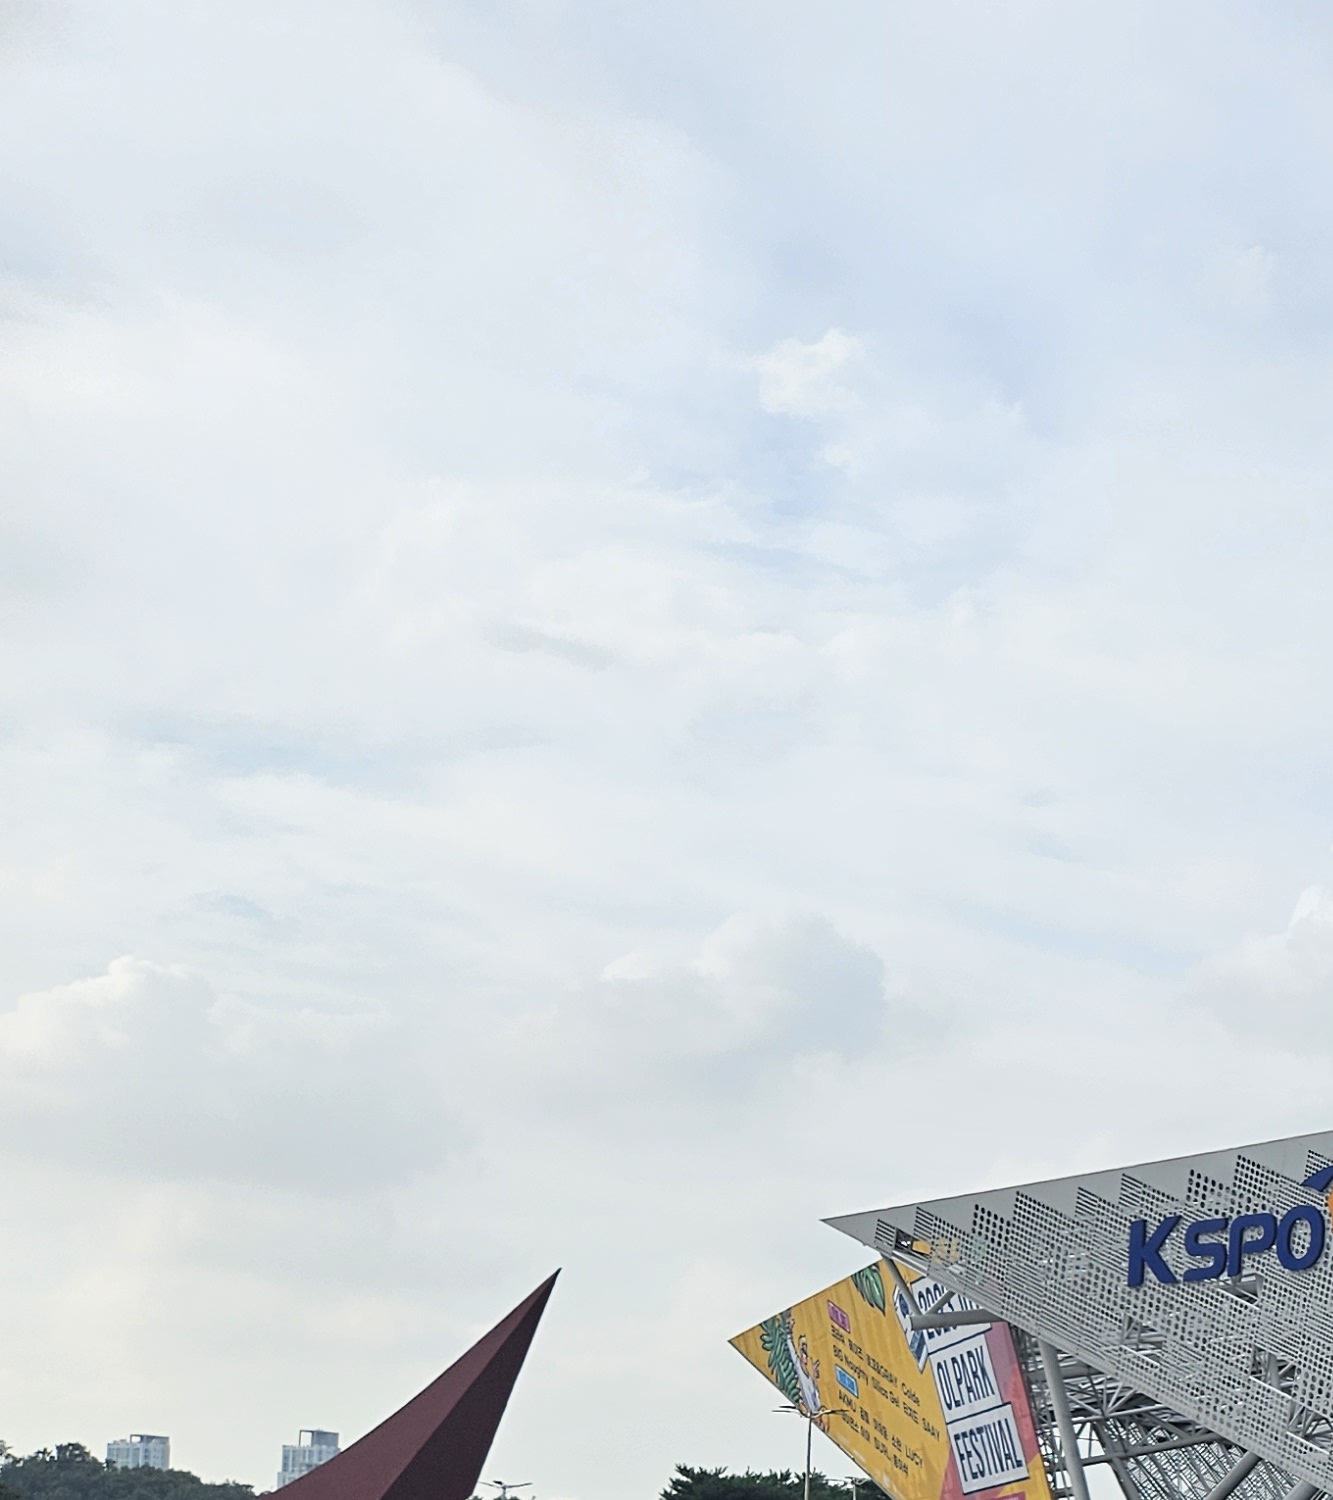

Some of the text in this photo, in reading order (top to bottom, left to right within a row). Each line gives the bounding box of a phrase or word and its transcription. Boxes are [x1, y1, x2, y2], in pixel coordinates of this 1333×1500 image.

[1127, 1203, 1325, 1288] KSPO
[937, 1345, 995, 1411] OLPARK
[954, 1418, 1024, 1482] FESTIVAL
